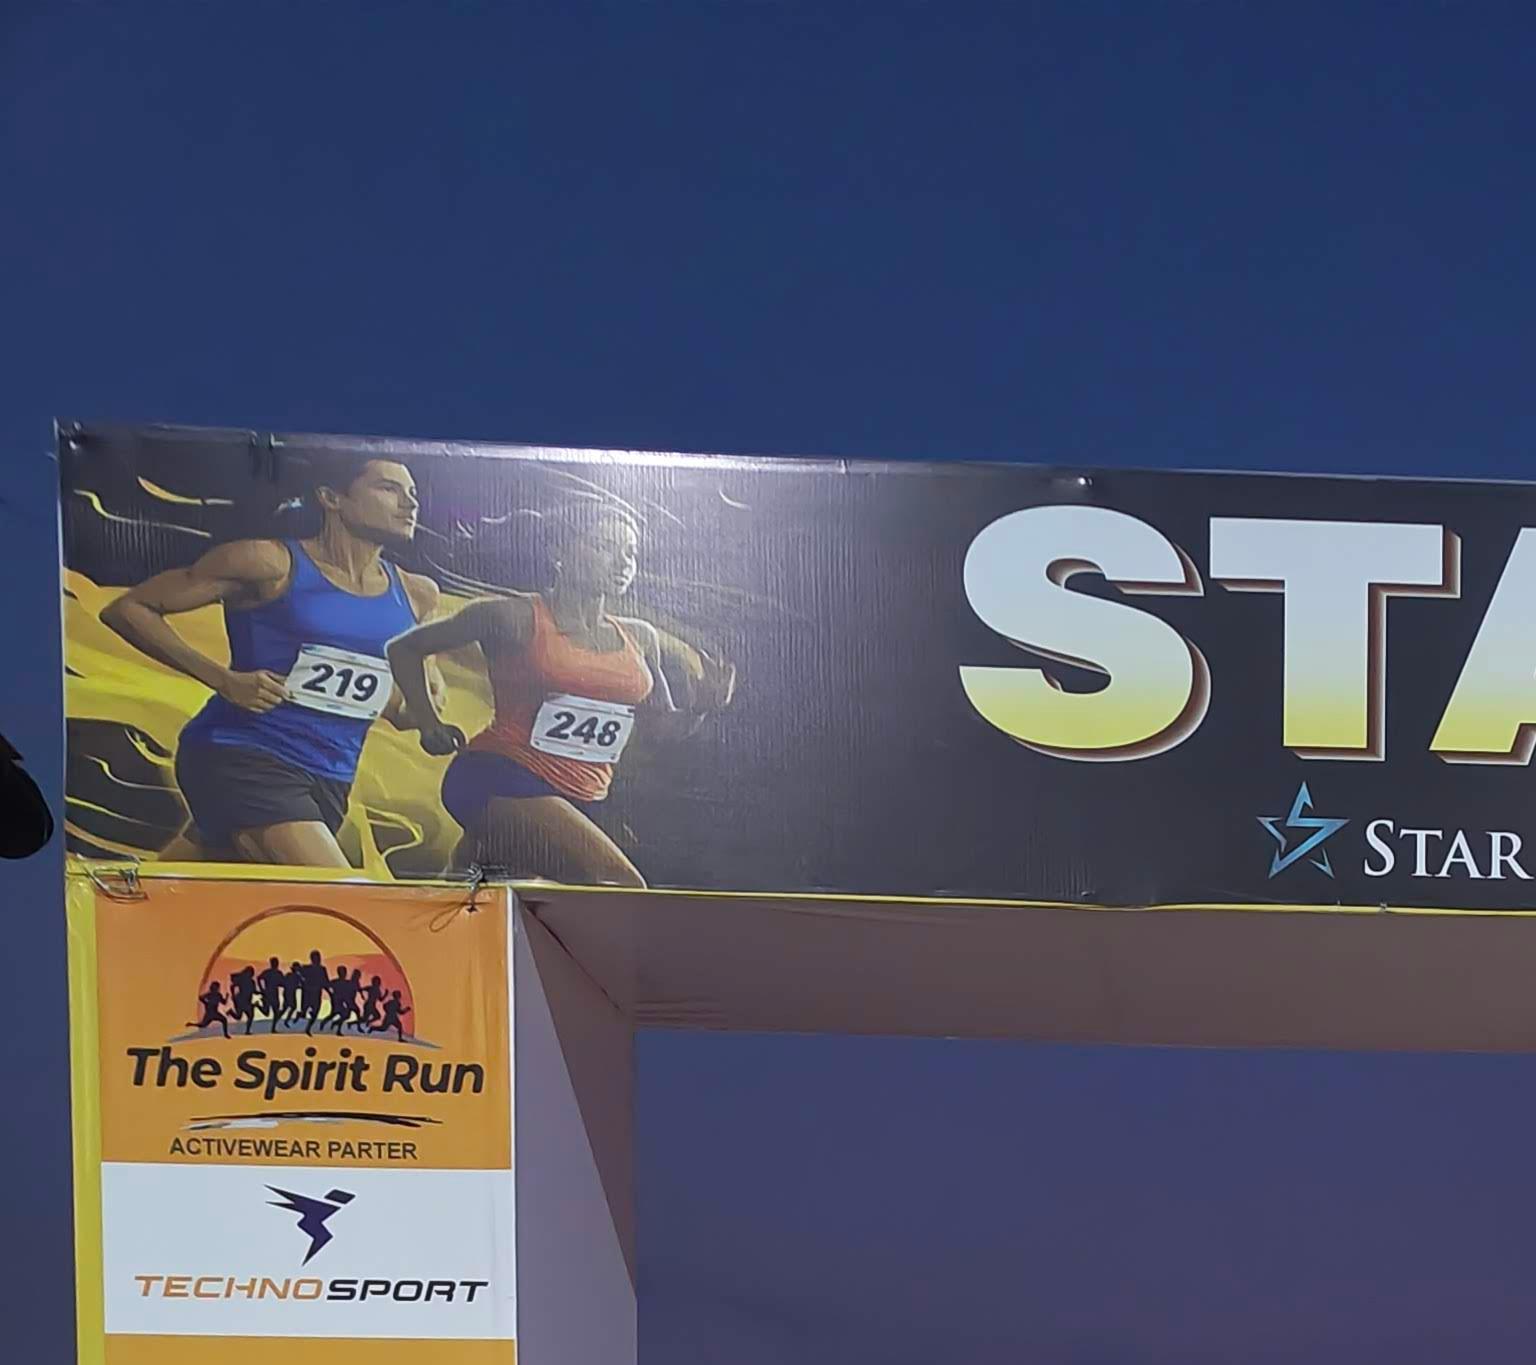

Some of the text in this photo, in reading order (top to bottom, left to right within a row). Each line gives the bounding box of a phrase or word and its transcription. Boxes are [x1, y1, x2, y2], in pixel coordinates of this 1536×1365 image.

[302, 661, 379, 703] 219
[545, 711, 621, 747] 248
[1365, 817, 1532, 880] STAR
[126, 1047, 485, 1100] The Spirit Run
[169, 1137, 418, 1160] ACTIVEWEAR PARTER
[134, 1275, 489, 1303] TECHNOSPORT
